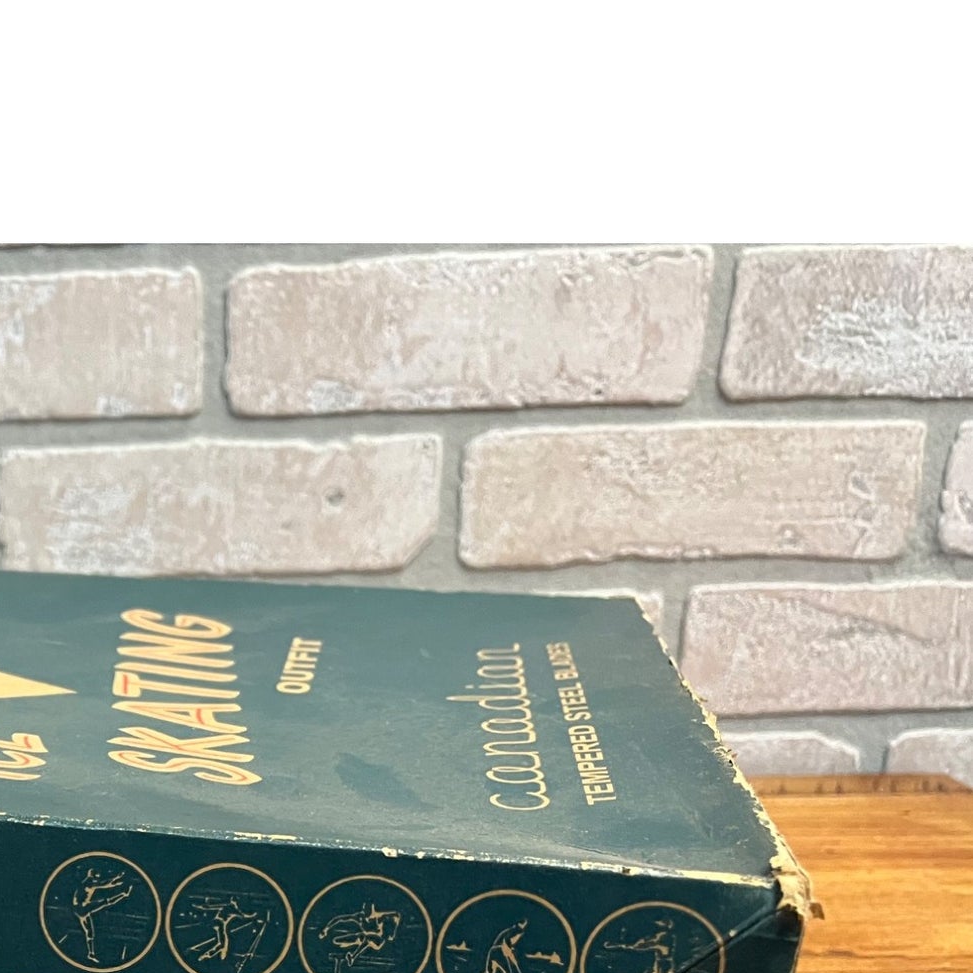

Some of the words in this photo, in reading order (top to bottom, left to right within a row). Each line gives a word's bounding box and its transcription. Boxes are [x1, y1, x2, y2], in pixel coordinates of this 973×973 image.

[107, 608, 262, 786] SKATING
[276, 637, 322, 695] OUTFIT
[557, 682, 592, 721] STEEL
[445, 643, 550, 811] canadian
[568, 725, 617, 806] TEMPERED
